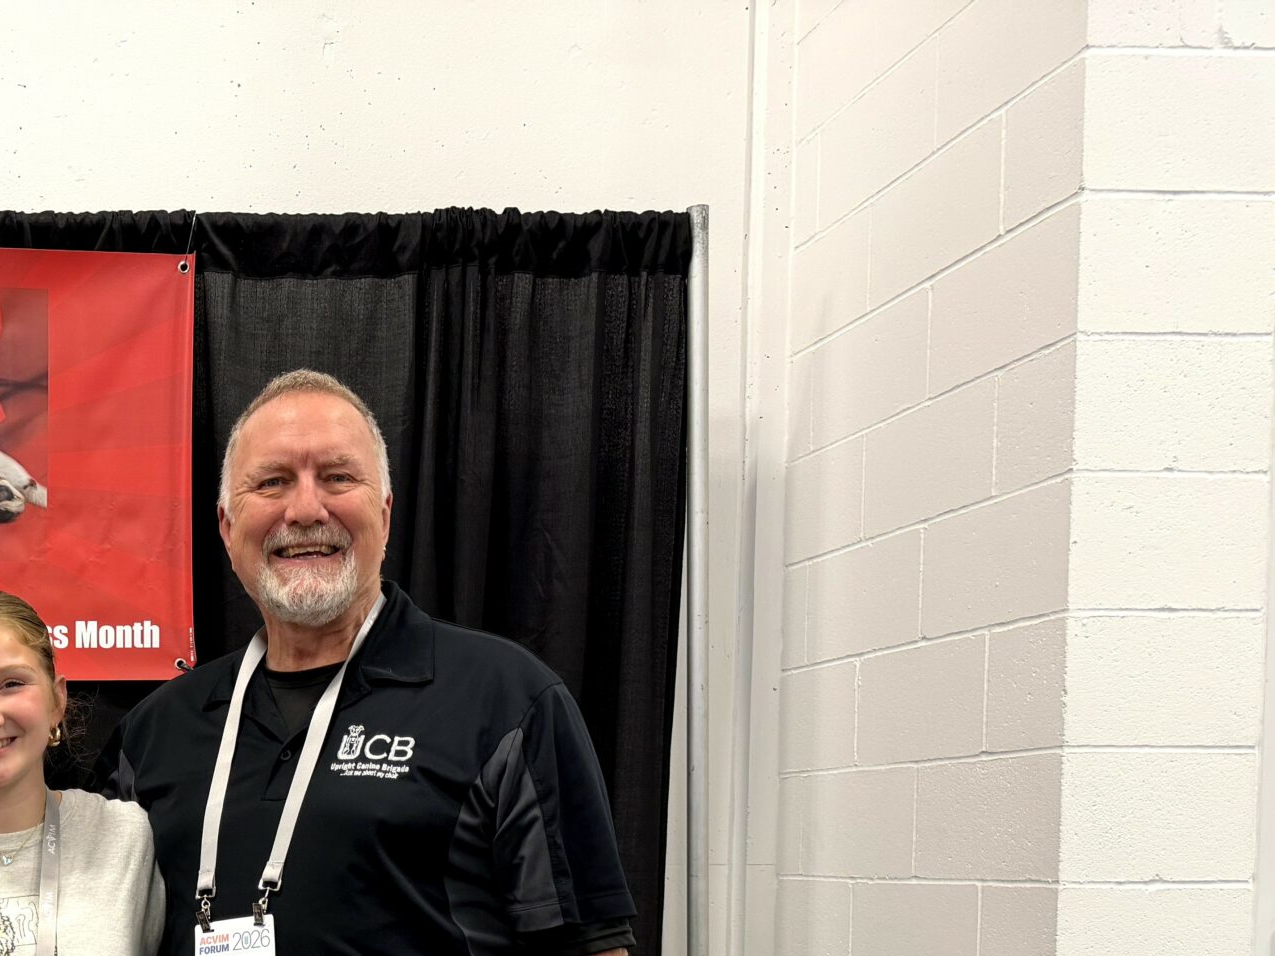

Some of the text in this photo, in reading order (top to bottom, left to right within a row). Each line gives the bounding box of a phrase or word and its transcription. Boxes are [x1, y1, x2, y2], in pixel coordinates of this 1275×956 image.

[75, 620, 160, 649] Month
[337, 733, 415, 761] UCB
[199, 943, 230, 956] FORUM
[200, 933, 230, 946] ACVIM
[232, 929, 271, 951] 2026
